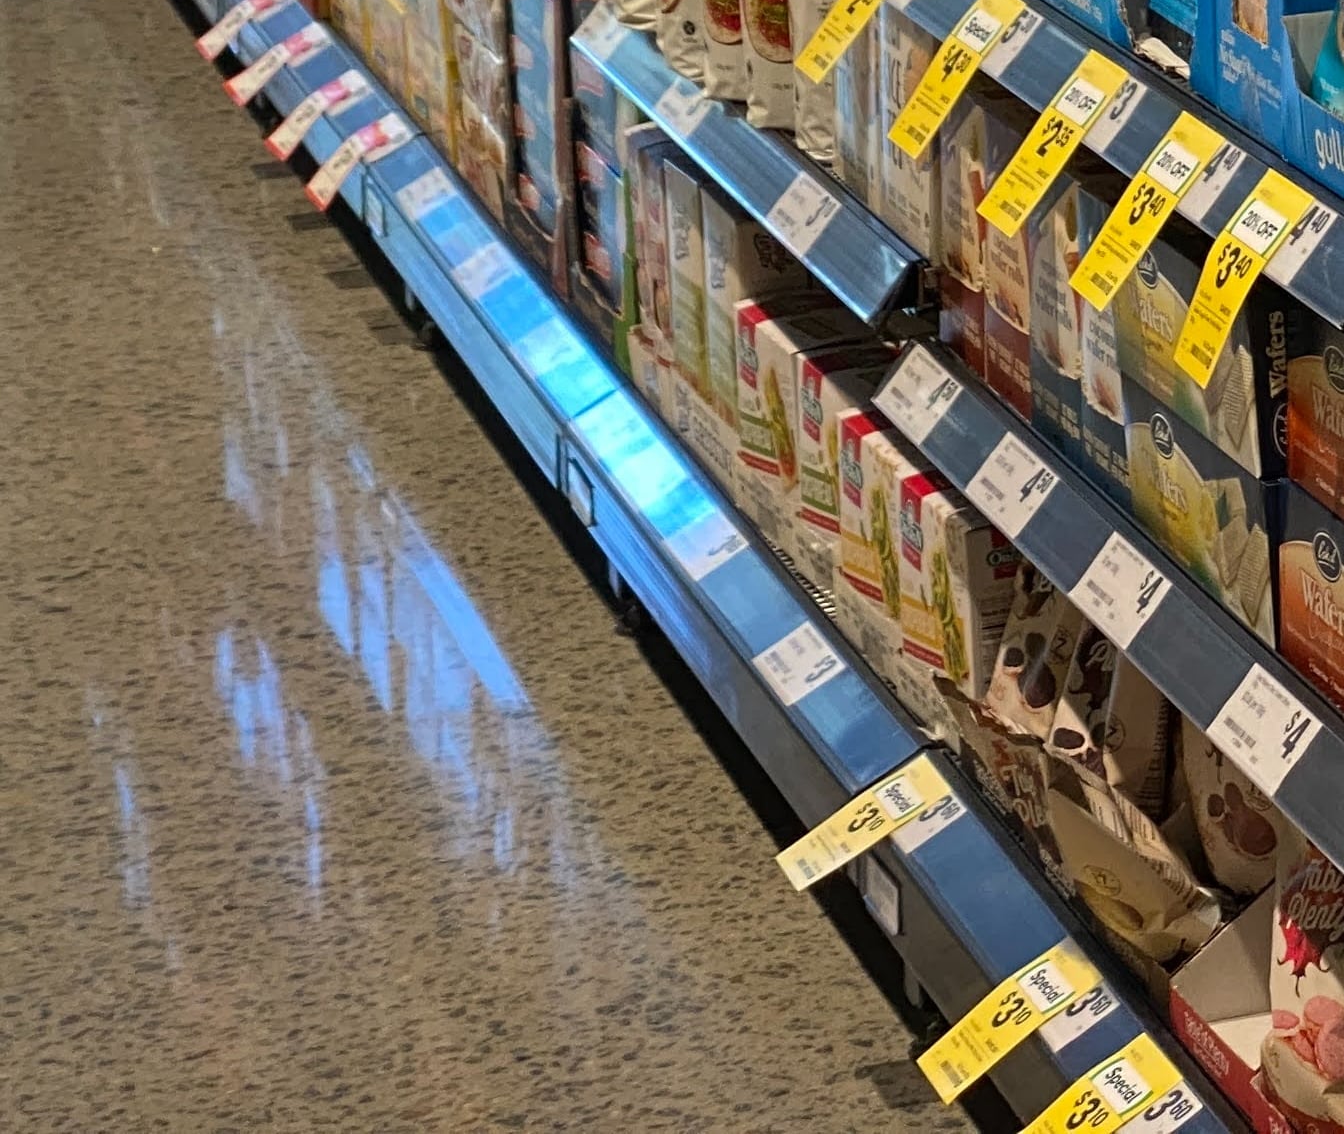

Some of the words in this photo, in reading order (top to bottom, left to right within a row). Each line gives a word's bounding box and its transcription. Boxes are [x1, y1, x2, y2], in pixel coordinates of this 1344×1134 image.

[1256, 220, 1277, 240] OFF
[1268, 309, 1287, 399] Wafers
[1030, 969, 1062, 1003] Special
[1105, 1067, 1142, 1104] Special
